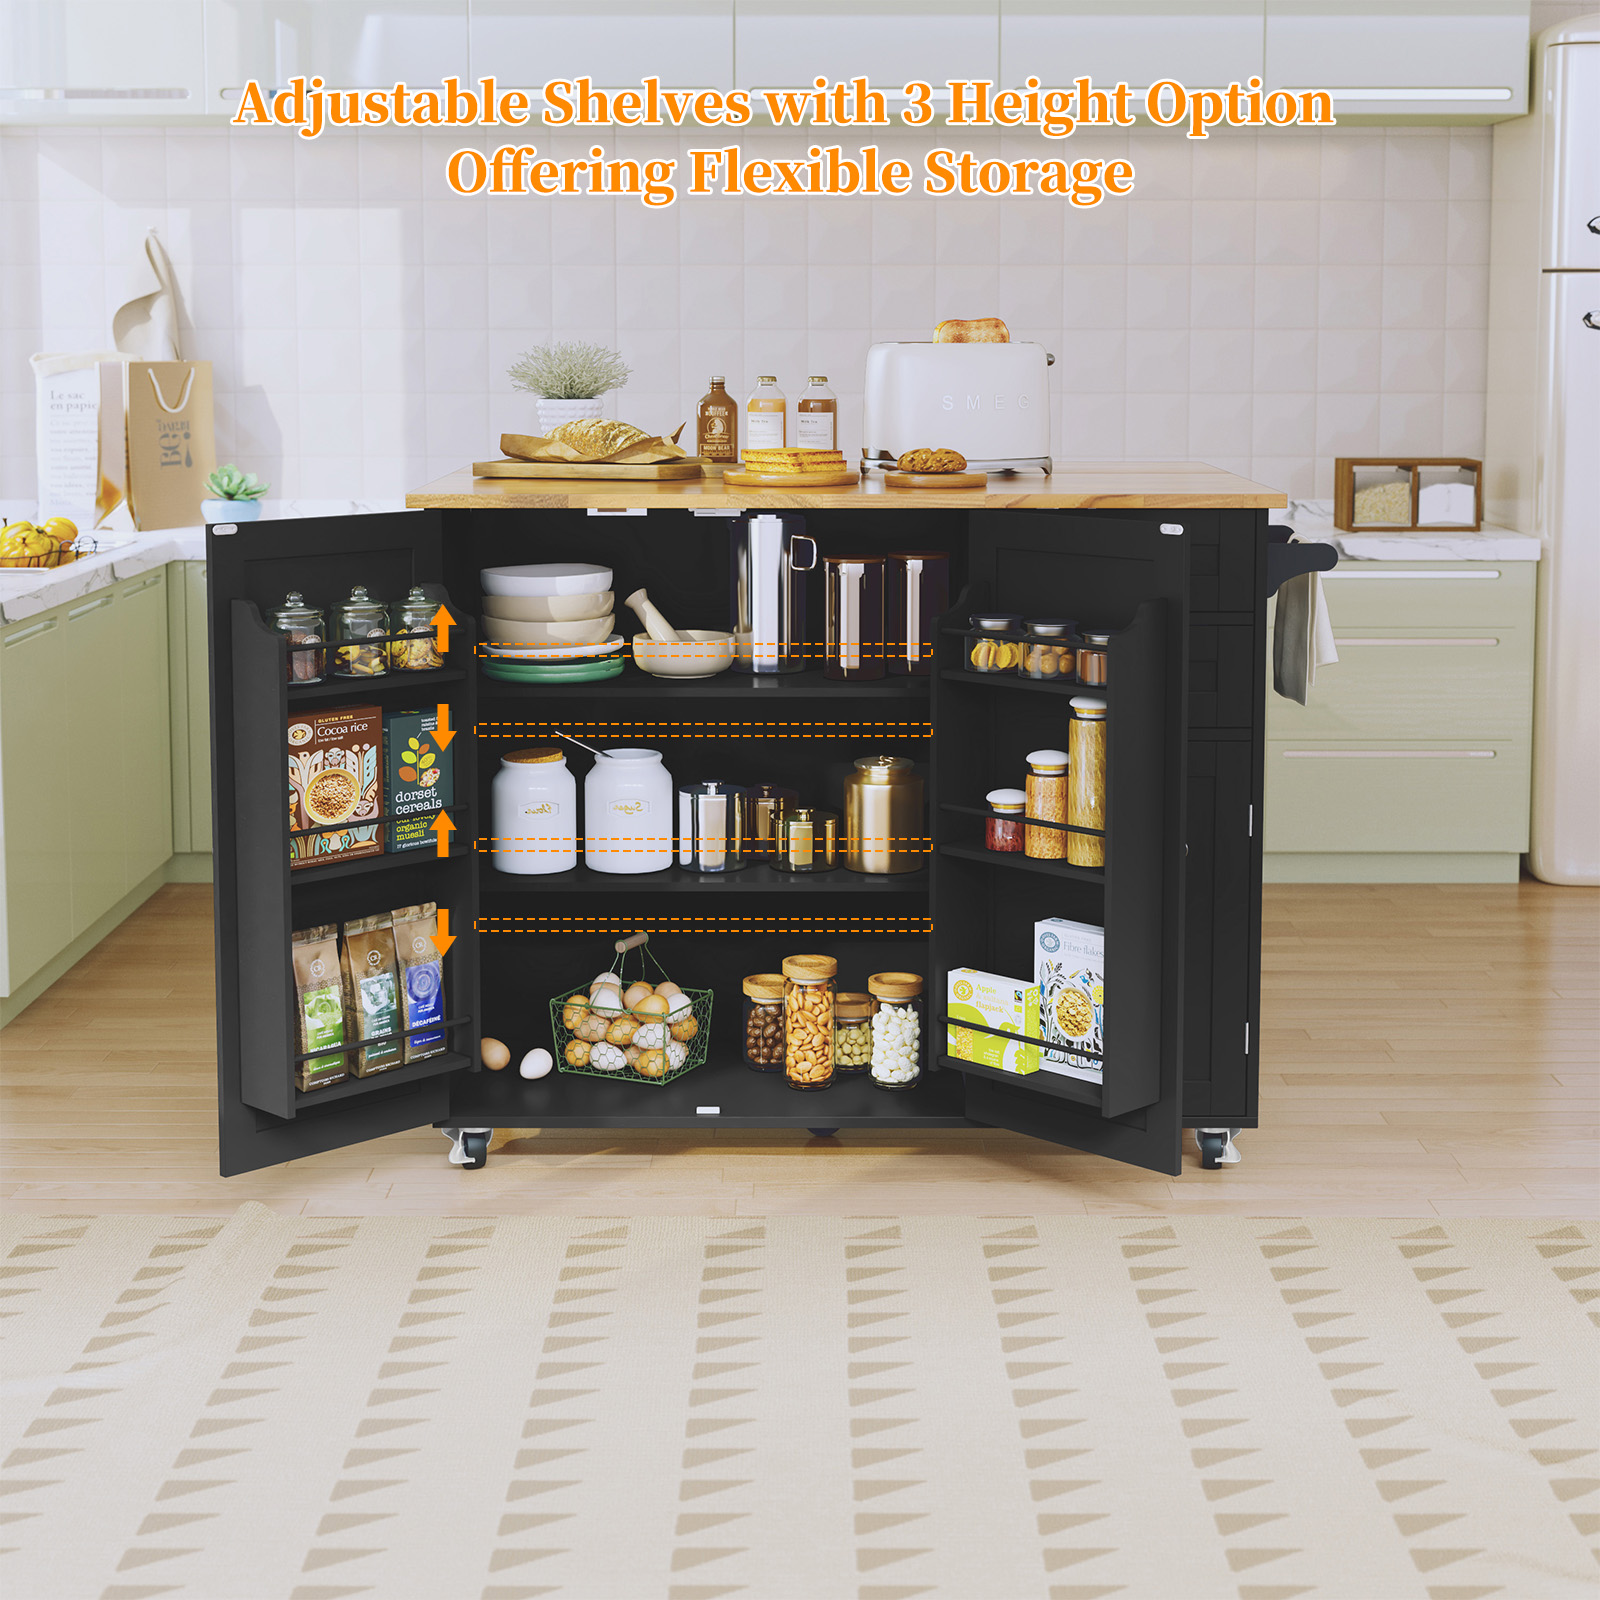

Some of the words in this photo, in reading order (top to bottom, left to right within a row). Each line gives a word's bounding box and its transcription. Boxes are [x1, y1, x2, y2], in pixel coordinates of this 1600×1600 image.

[50, 390, 64, 400] Le
[67, 392, 85, 400] sac
[50, 402, 64, 410] en
[66, 401, 98, 412] papie
[941, 394, 1031, 411] SMEG
[317, 725, 348, 737] Cocoa
[350, 722, 369, 733] rice
[395, 786, 438, 803] dorset
[395, 798, 443, 815] cereals
[396, 821, 428, 833] organic
[396, 829, 425, 841] muesli
[1063, 941, 1082, 952] Fibre
[976, 984, 997, 995] Apple
[975, 1000, 1004, 1014] flapjack
[370, 1026, 392, 1037] GRAINS
